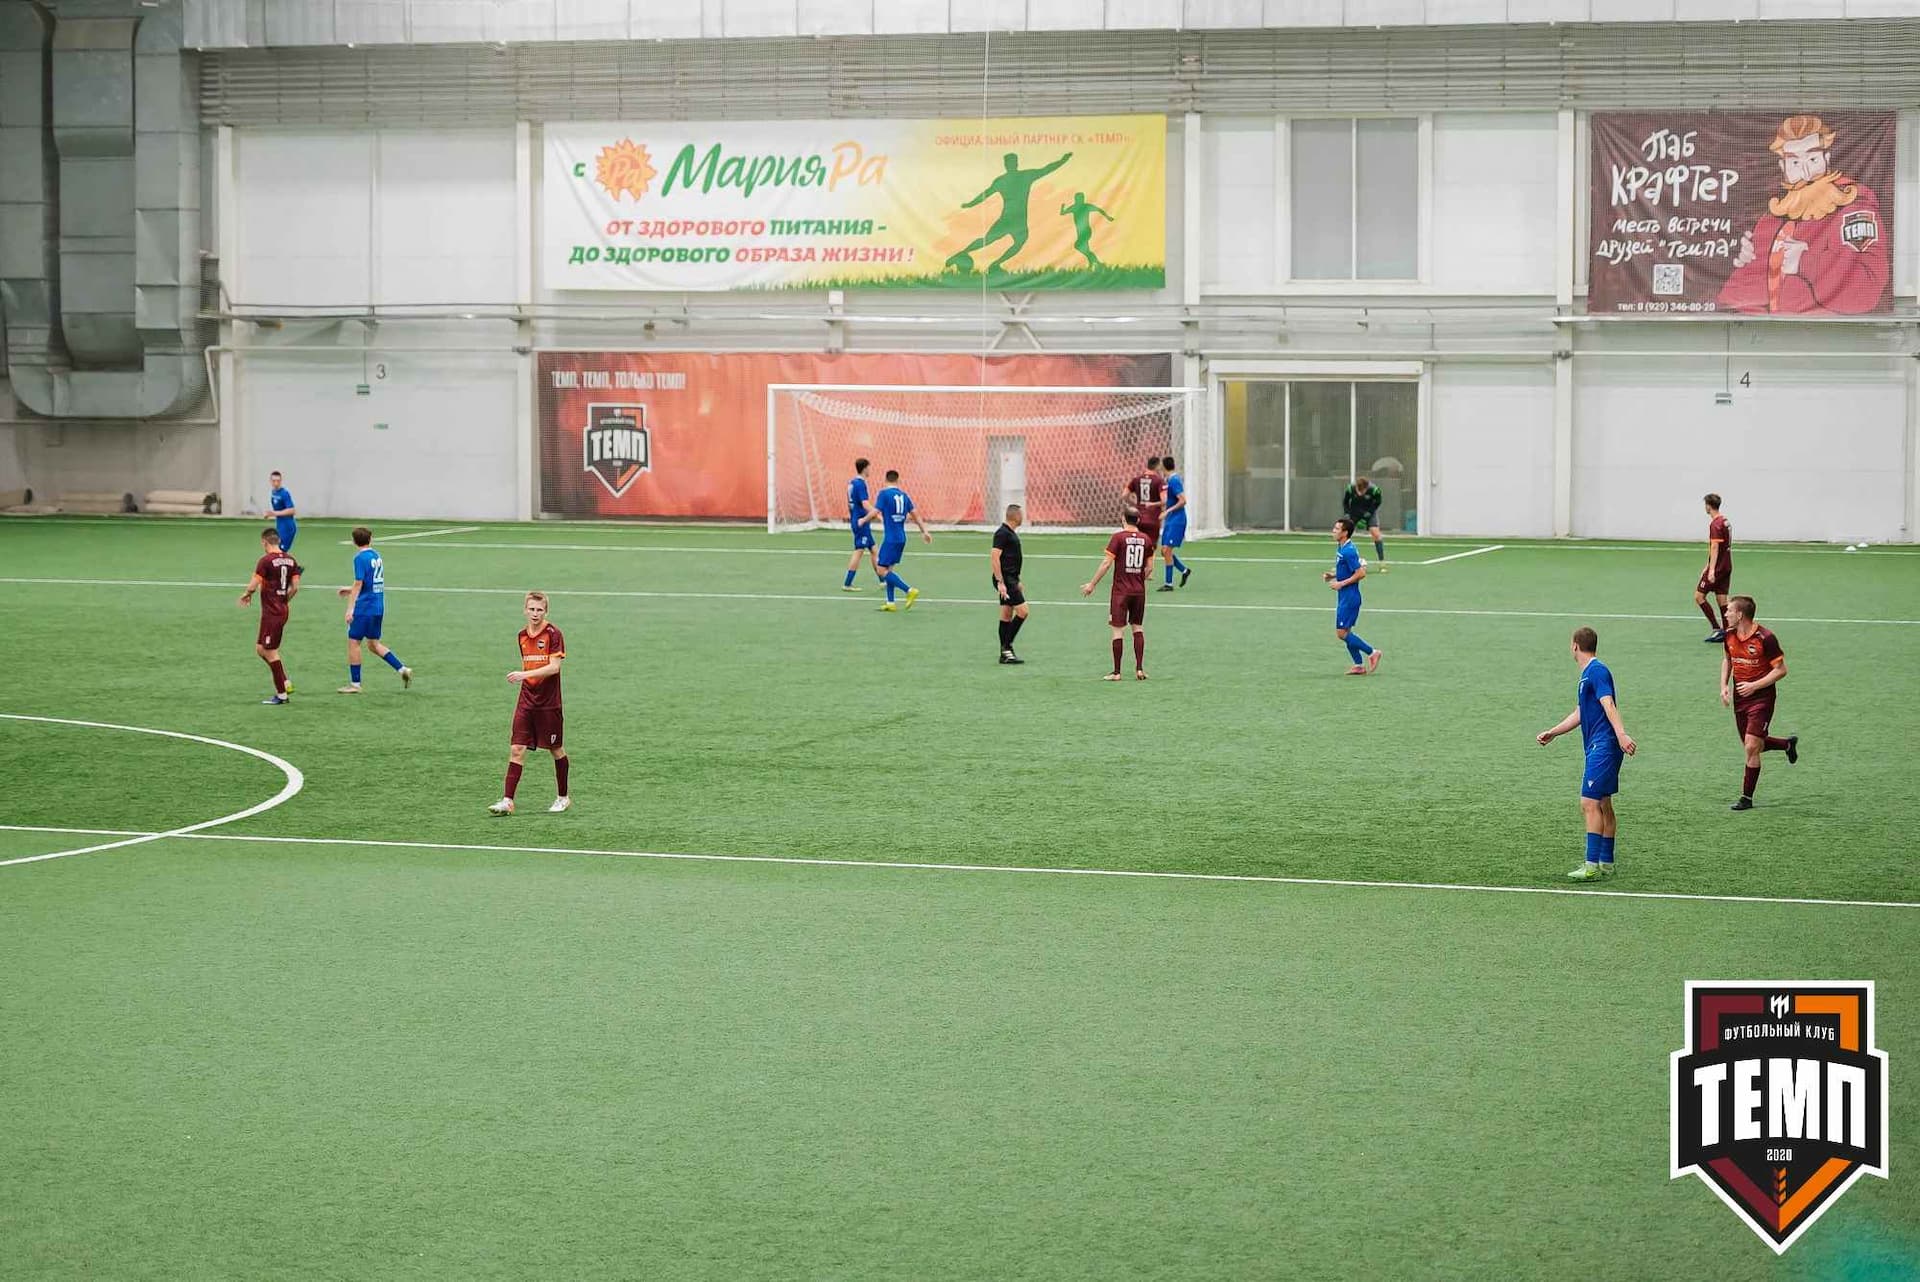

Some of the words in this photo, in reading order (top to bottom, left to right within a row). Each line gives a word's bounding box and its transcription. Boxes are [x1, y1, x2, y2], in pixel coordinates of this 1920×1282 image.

[1023, 132, 1068, 145] ПАРТНЕР
[606, 220, 633, 236] ОТ
[638, 220, 765, 238] ЗДОРОВОГО
[769, 219, 874, 236] ПИТАНИЯ
[1844, 222, 1875, 241] ТЕМП
[568, 246, 600, 264] ДО
[603, 247, 731, 265] ЗДОРОВОГО
[735, 247, 816, 263] ОБРАЗА
[375, 363, 386, 379] 3
[1739, 372, 1751, 388] 4
[590, 429, 646, 463] ТЕМП
[1140, 483, 1151, 502] 13
[893, 494, 905, 514] 11
[1125, 545, 1145, 568] 60
[371, 557, 384, 583] 22
